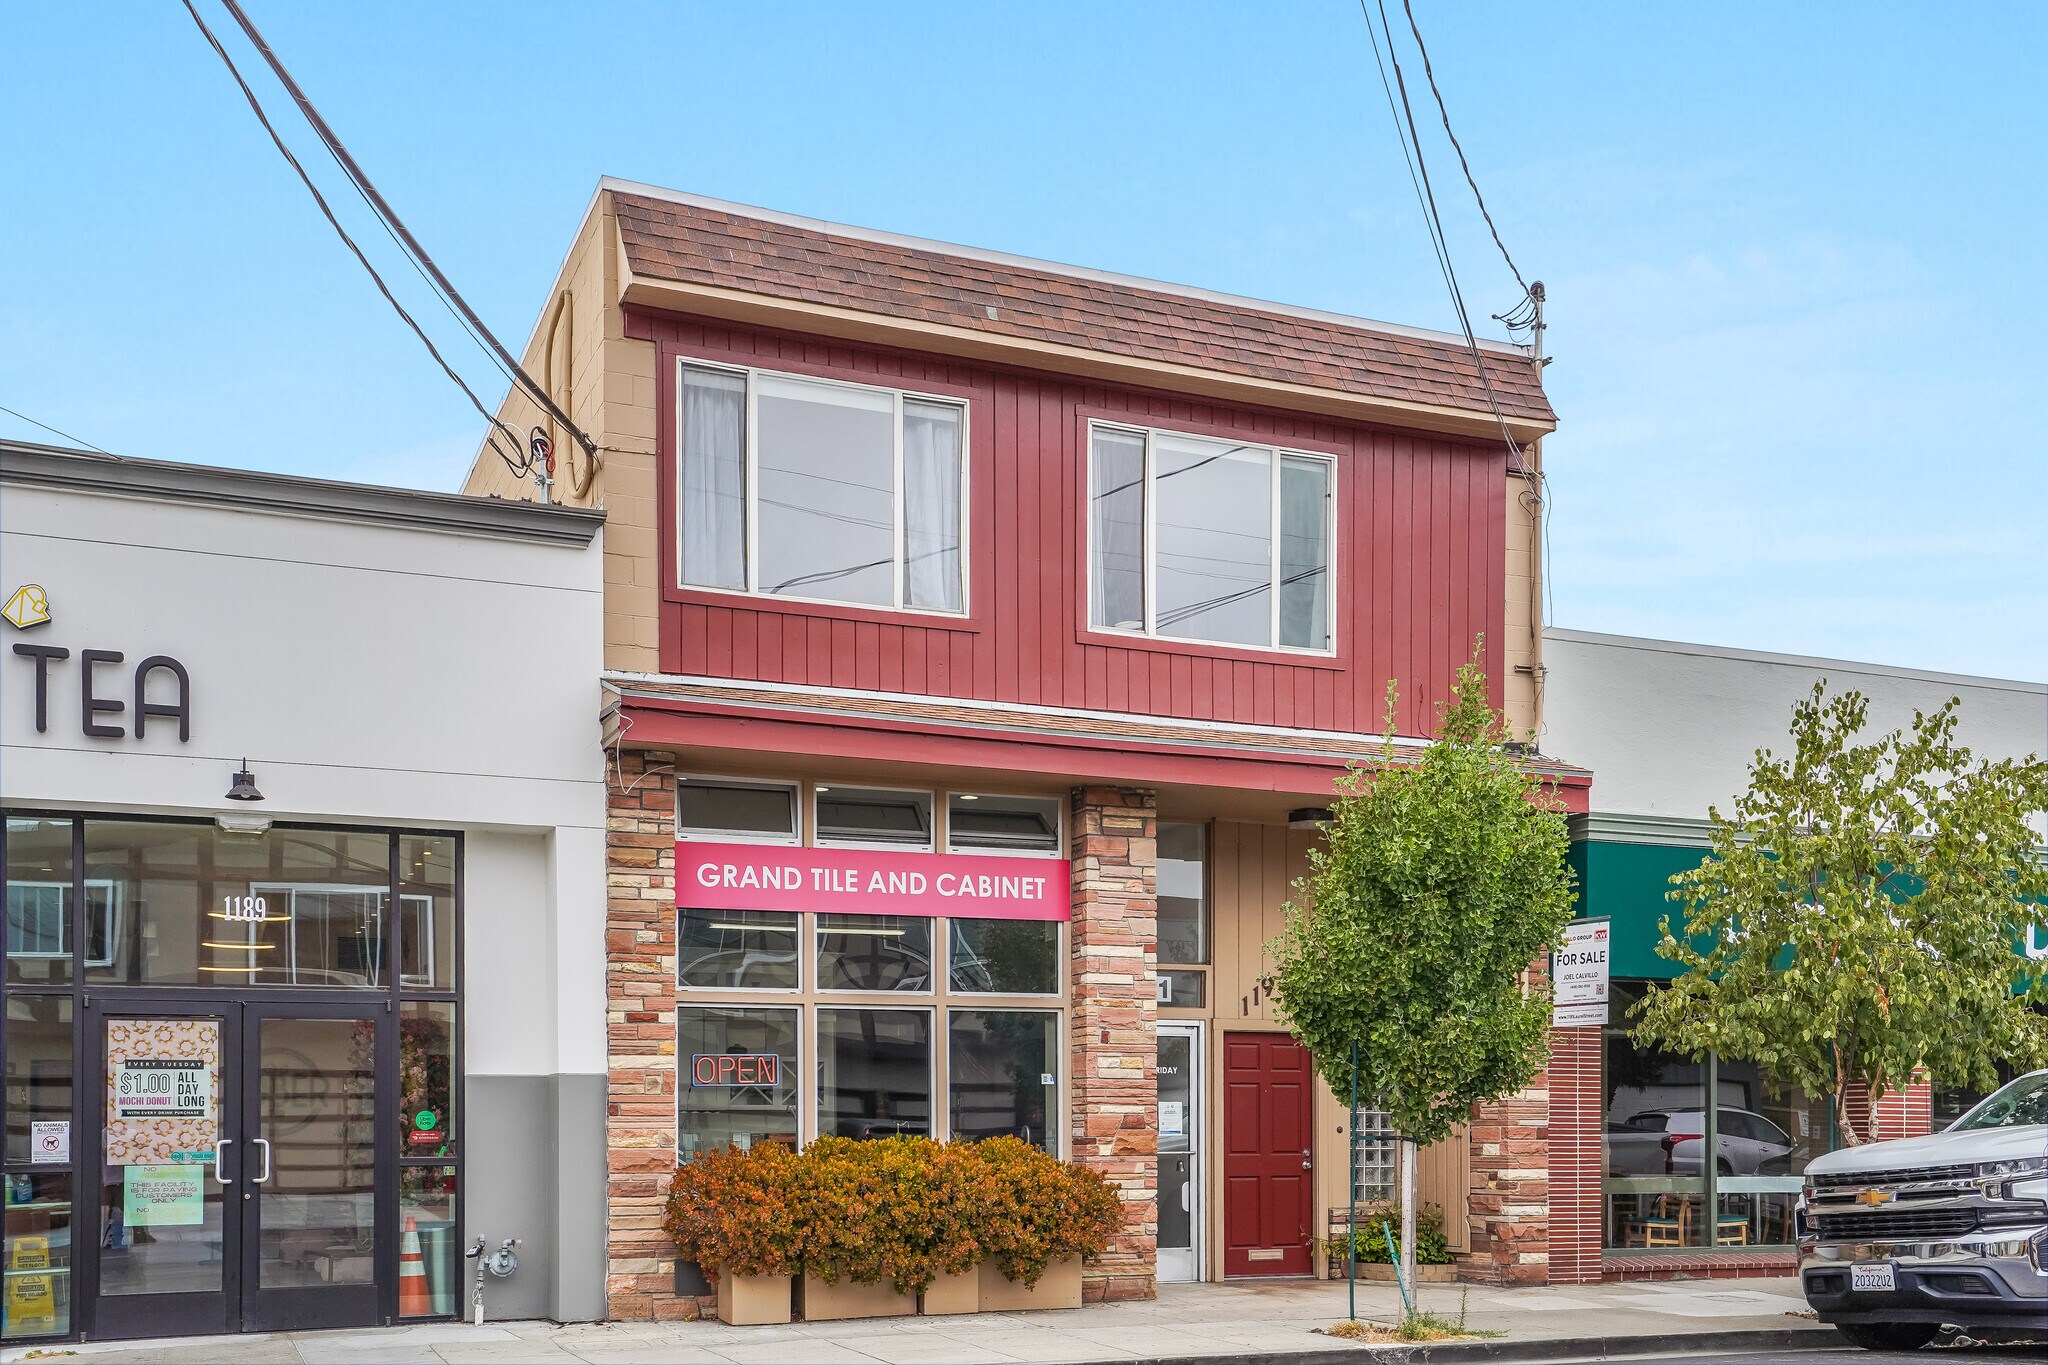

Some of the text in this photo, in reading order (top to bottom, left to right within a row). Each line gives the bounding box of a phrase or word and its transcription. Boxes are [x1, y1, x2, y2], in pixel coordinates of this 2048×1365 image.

[12, 643, 190, 743] TEA
[697, 862, 1045, 900] GRAND TILE AND CABINET
[224, 896, 266, 922] 1189
[1594, 931, 1607, 940] KW
[1556, 951, 1605, 966] FOR SALE
[1576, 971, 1599, 979] CALVILLO
[696, 1056, 776, 1084] OPEN
[120, 1072, 171, 1094] $1.00
[178, 1072, 197, 1083] ALL
[178, 1084, 199, 1095] DAY
[119, 1097, 172, 1105] MOCHI DONUT
[177, 1096, 205, 1107] LONG
[1855, 1275, 1892, 1287] 20322U2
